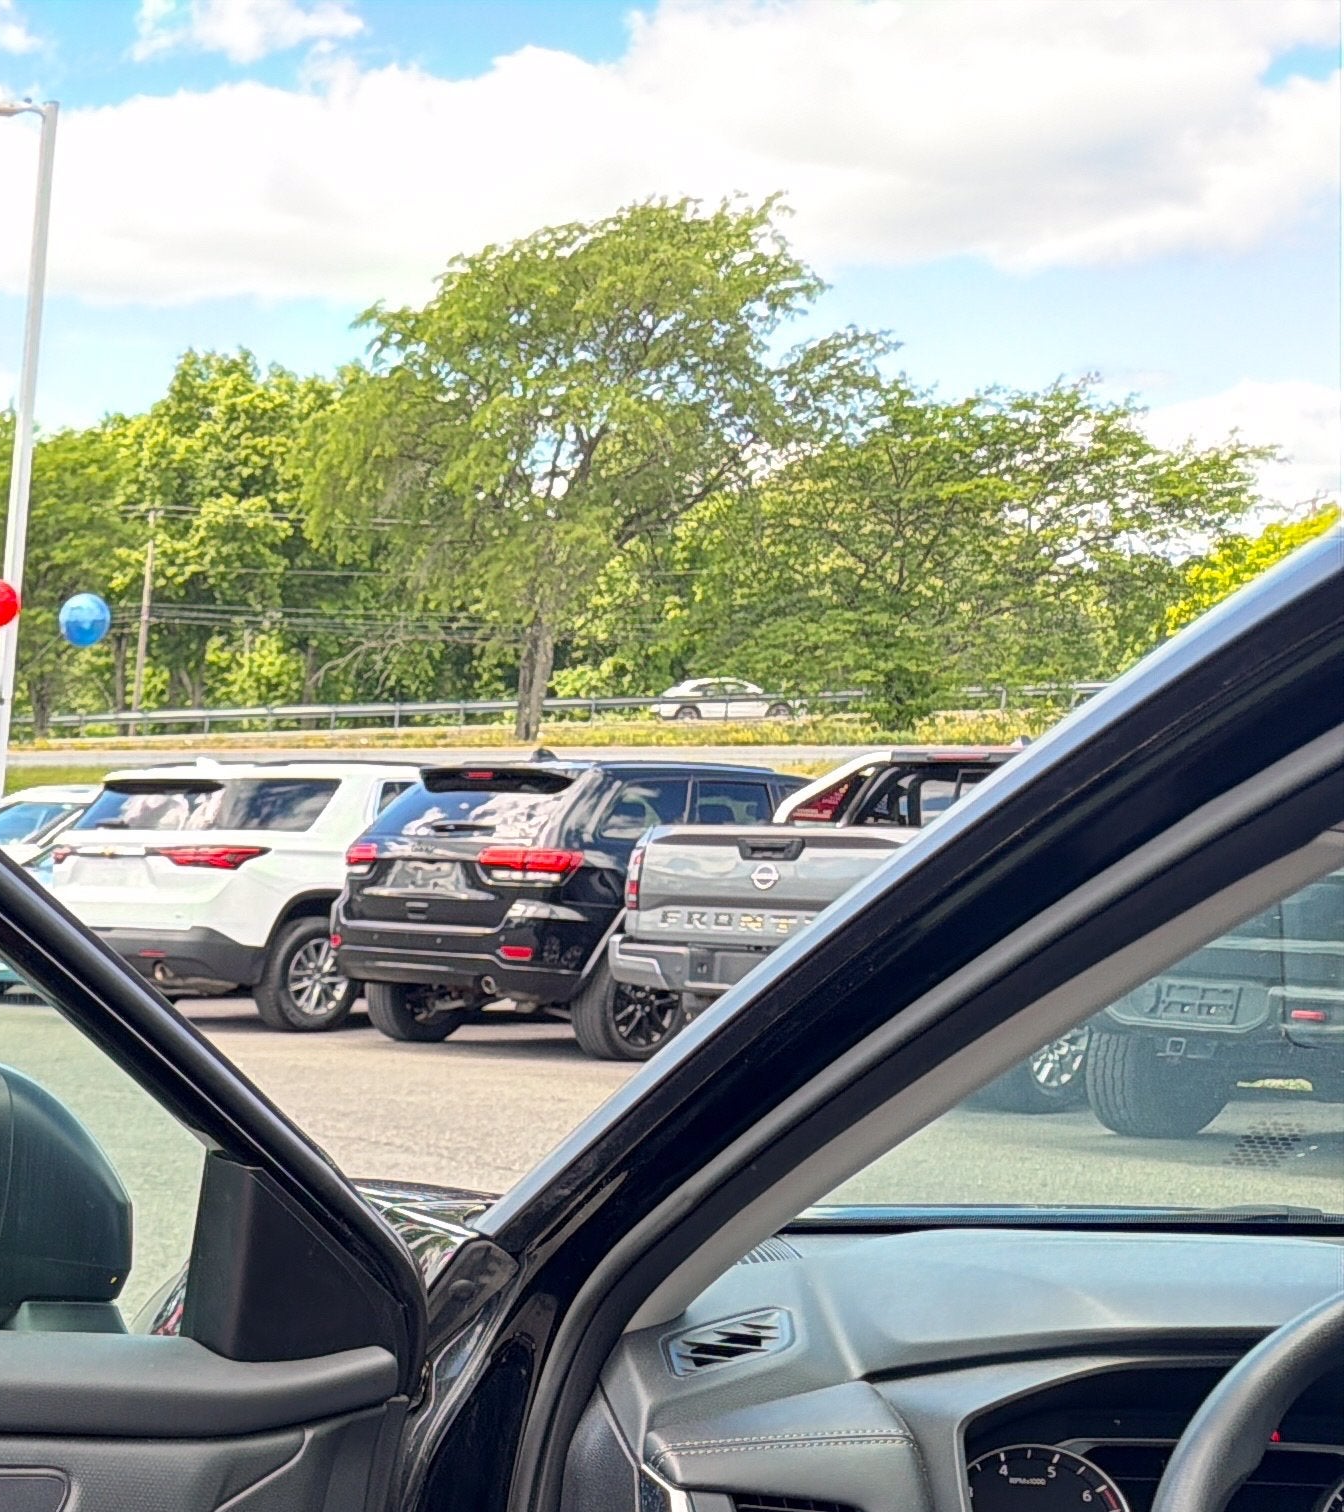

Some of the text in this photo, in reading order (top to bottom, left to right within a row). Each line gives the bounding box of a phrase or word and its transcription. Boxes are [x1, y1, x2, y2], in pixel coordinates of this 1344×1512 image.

[658, 909, 817, 934] FRONT
[999, 1464, 1009, 1476] 4
[1047, 1466, 1057, 1478] 5
[1082, 1489, 1092, 1502] 6
